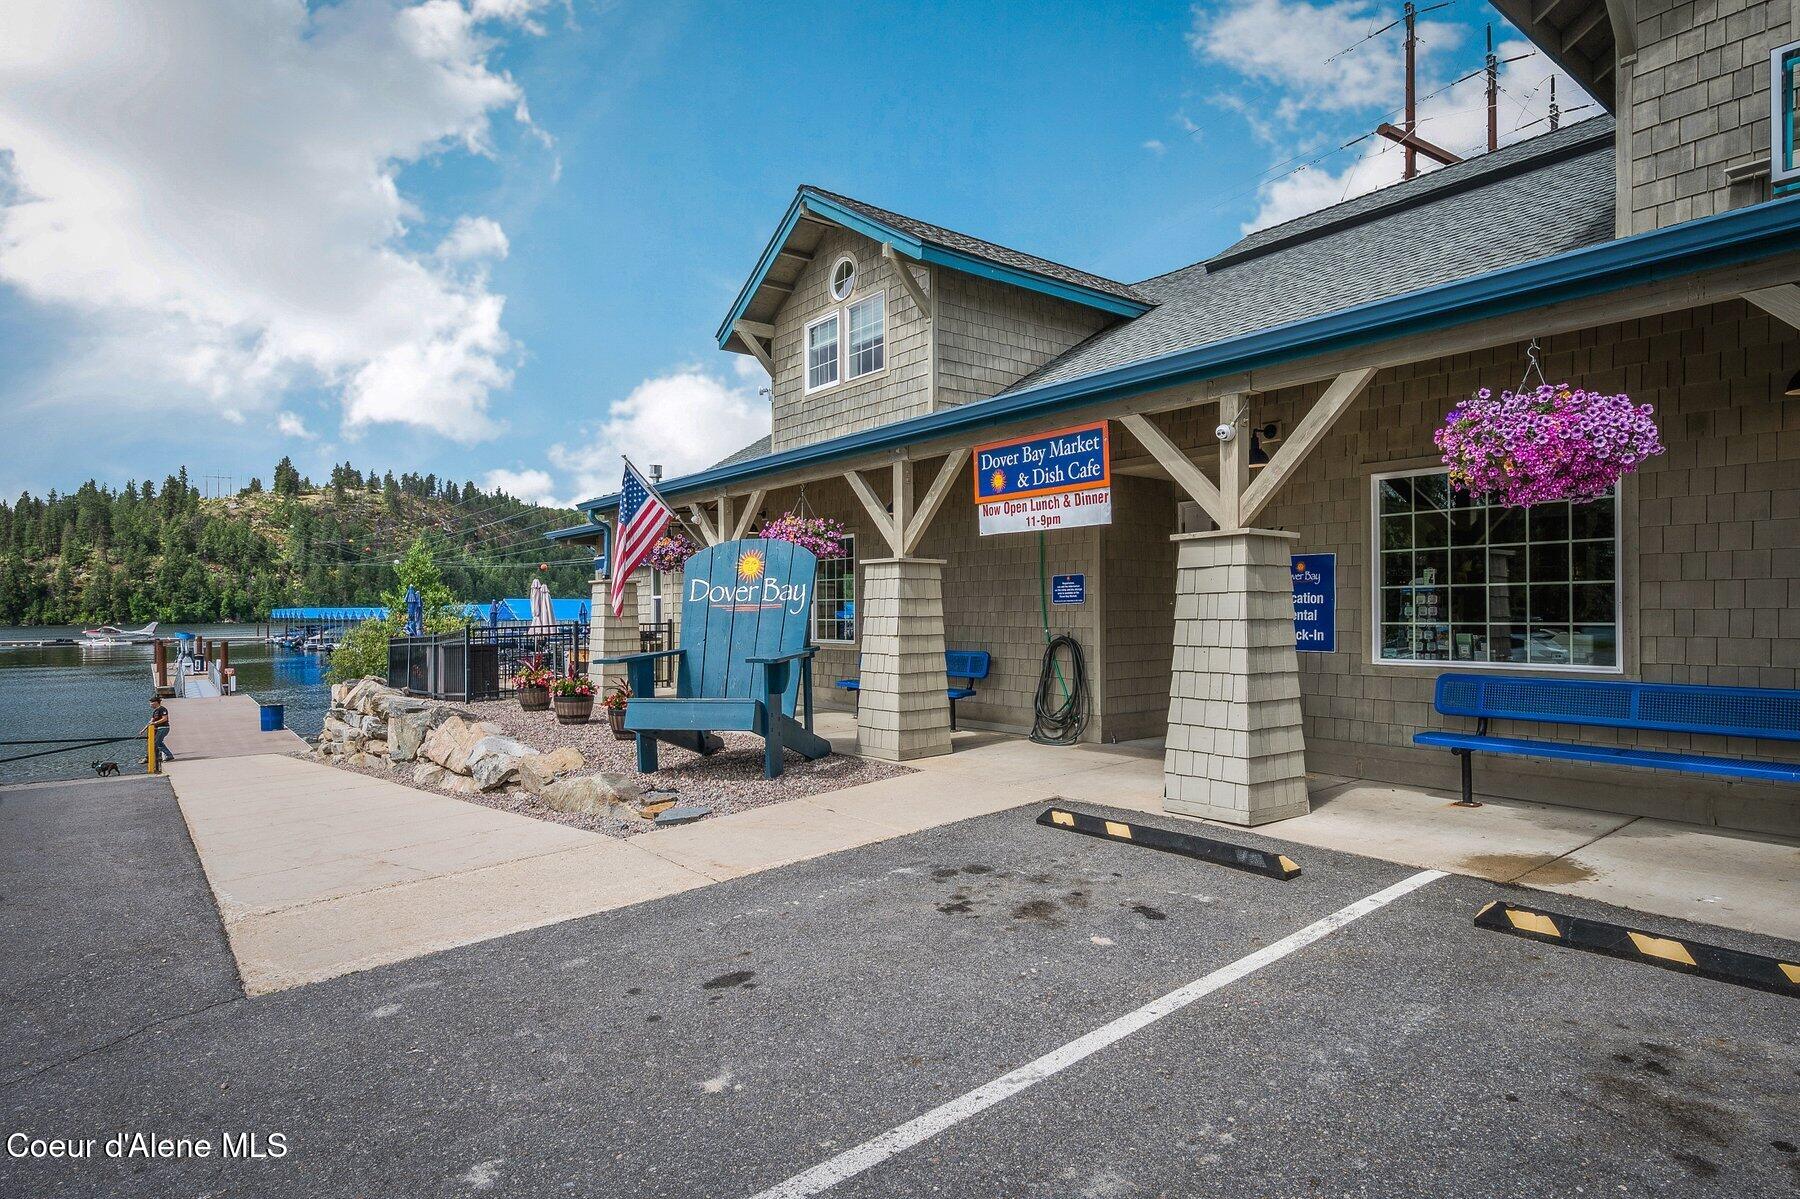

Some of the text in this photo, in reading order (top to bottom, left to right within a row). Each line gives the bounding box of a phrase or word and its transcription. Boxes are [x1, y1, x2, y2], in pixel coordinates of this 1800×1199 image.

[982, 435, 1100, 470] Dover Bay Market
[1018, 459, 1100, 488] & Dish Cafe
[982, 492, 1109, 516] Now Open Lunch & Dinner
[1026, 514, 1061, 528] 11-9pm
[1305, 570, 1320, 584] Bay
[688, 578, 806, 614] Dover Bay
[1292, 592, 1324, 604] cation
[1293, 610, 1317, 620] ental
[1296, 629, 1324, 640] ck-In
